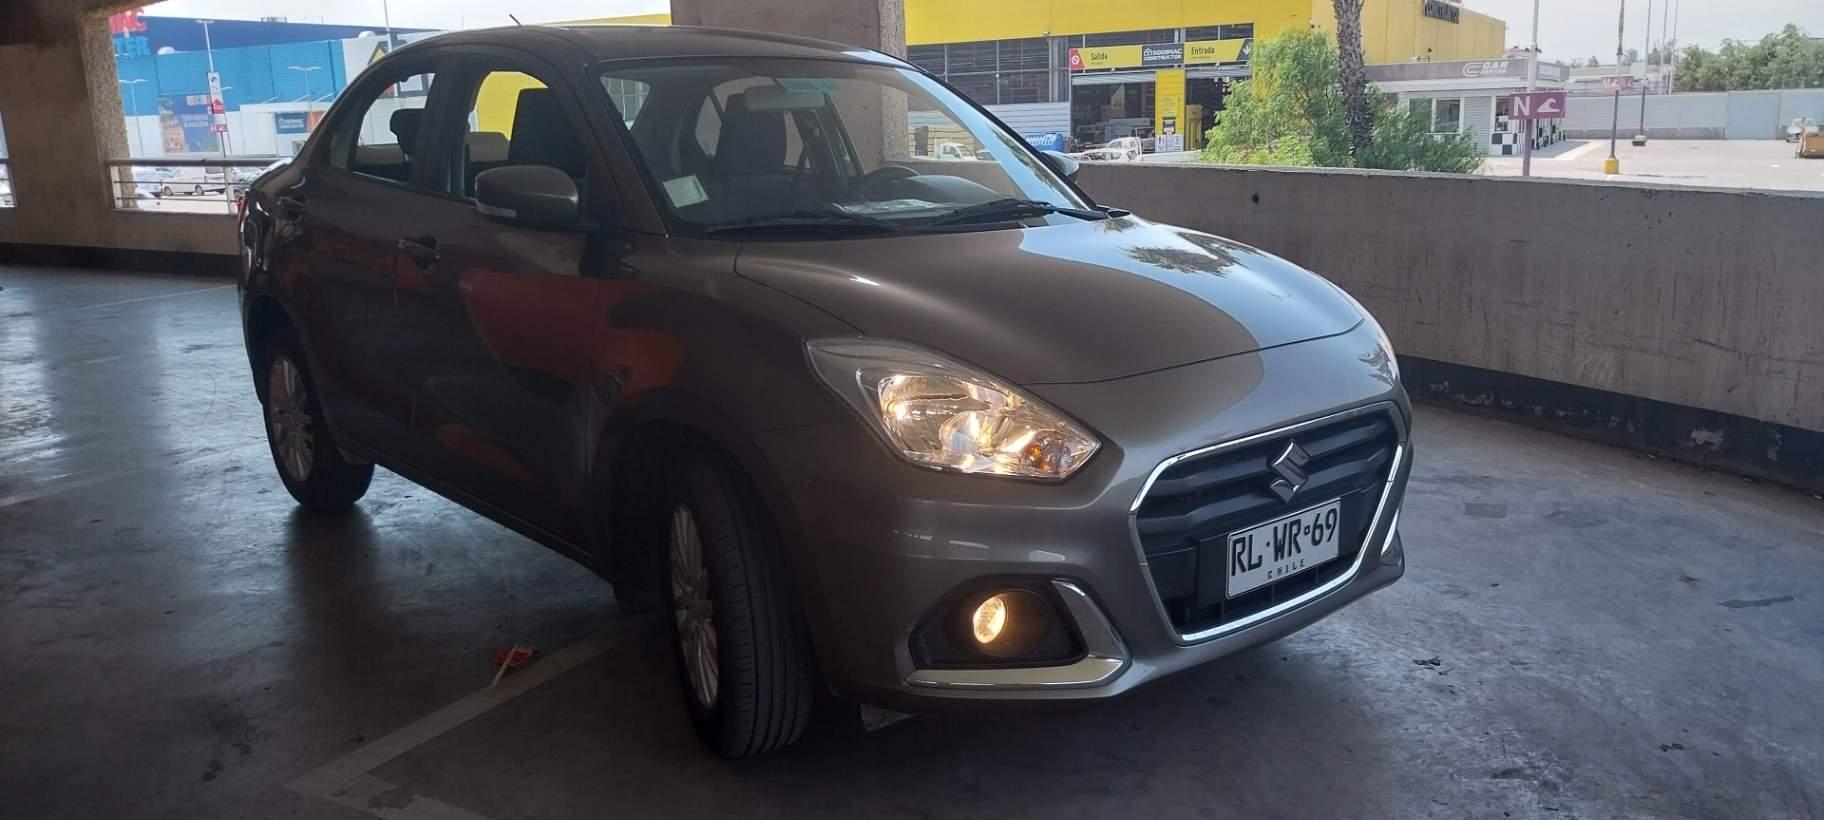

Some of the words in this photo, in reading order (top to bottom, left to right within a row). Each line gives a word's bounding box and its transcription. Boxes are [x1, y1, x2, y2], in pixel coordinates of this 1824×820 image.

[1090, 52, 1108, 60] Salida
[1191, 46, 1215, 55] Entrada
[1513, 95, 1531, 117] N
[1267, 558, 1305, 579] CHILE
